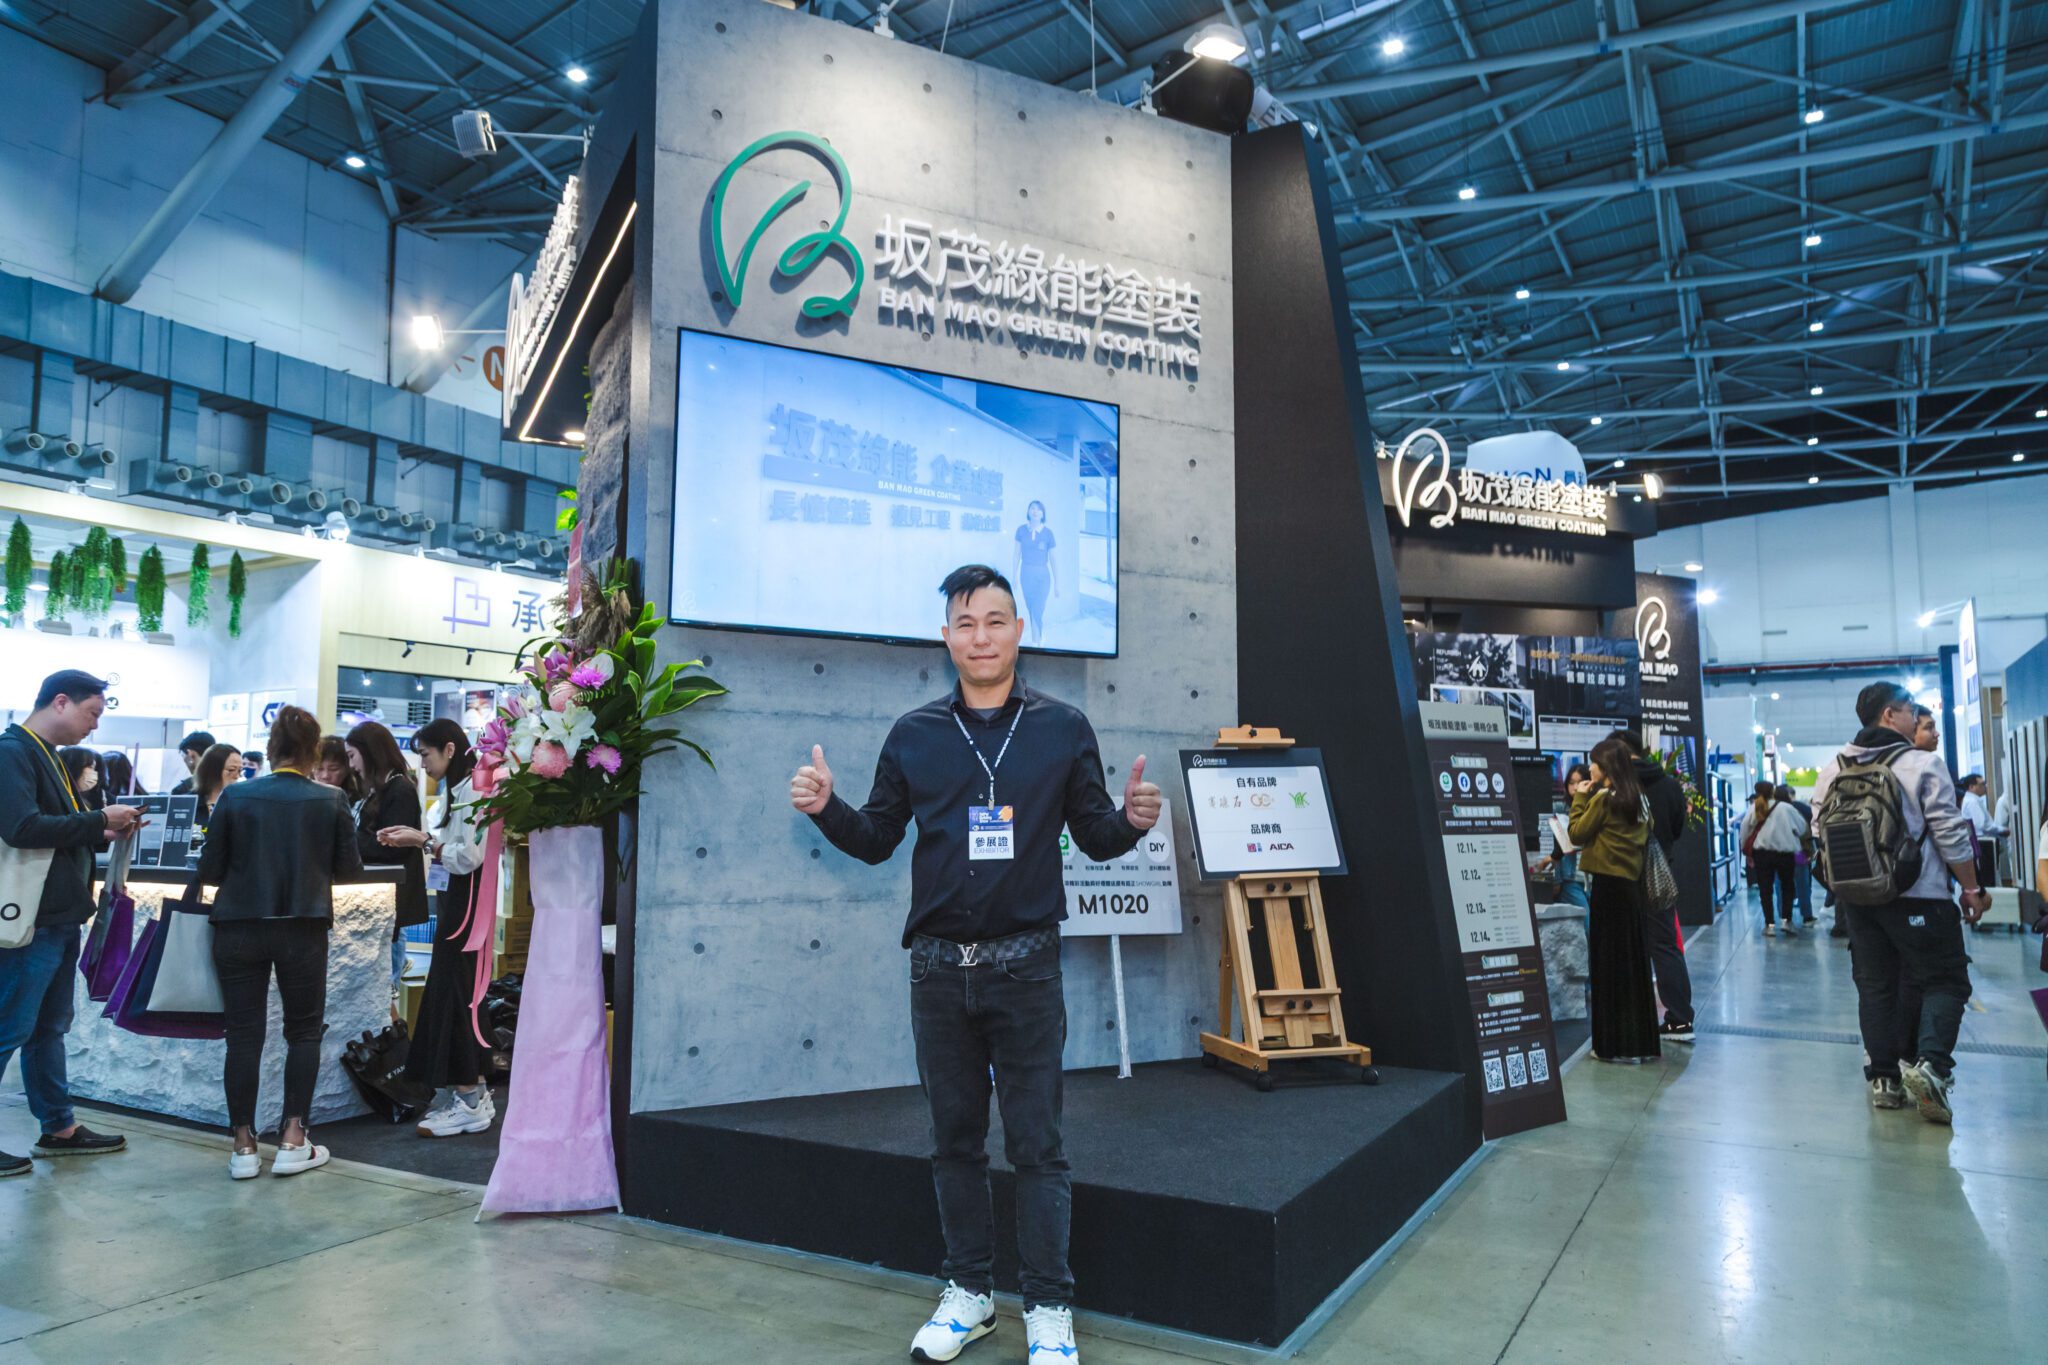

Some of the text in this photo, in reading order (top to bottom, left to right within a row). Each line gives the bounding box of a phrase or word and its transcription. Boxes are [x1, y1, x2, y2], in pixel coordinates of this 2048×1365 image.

[874, 213, 1202, 339] 坂茂綠能塗裝
[878, 286, 1200, 367] BAN MAO GREEN COATING
[878, 480, 961, 502] BAN MAO GREEN COATING
[1458, 467, 1607, 521] 坂茂綠能塗裝
[1461, 506, 1607, 537] BAN MAO GREEN COATING
[511, 589, 546, 633] 承
[1638, 661, 1654, 675] AN
[1655, 662, 1679, 677] MAO
[1236, 776, 1277, 788] 自有品牌
[1250, 823, 1282, 835] 品牌商
[975, 836, 1009, 847] 參展證
[1149, 842, 1165, 852] DIY
[1269, 842, 1295, 851] AICA
[1078, 894, 1149, 915] M1020
